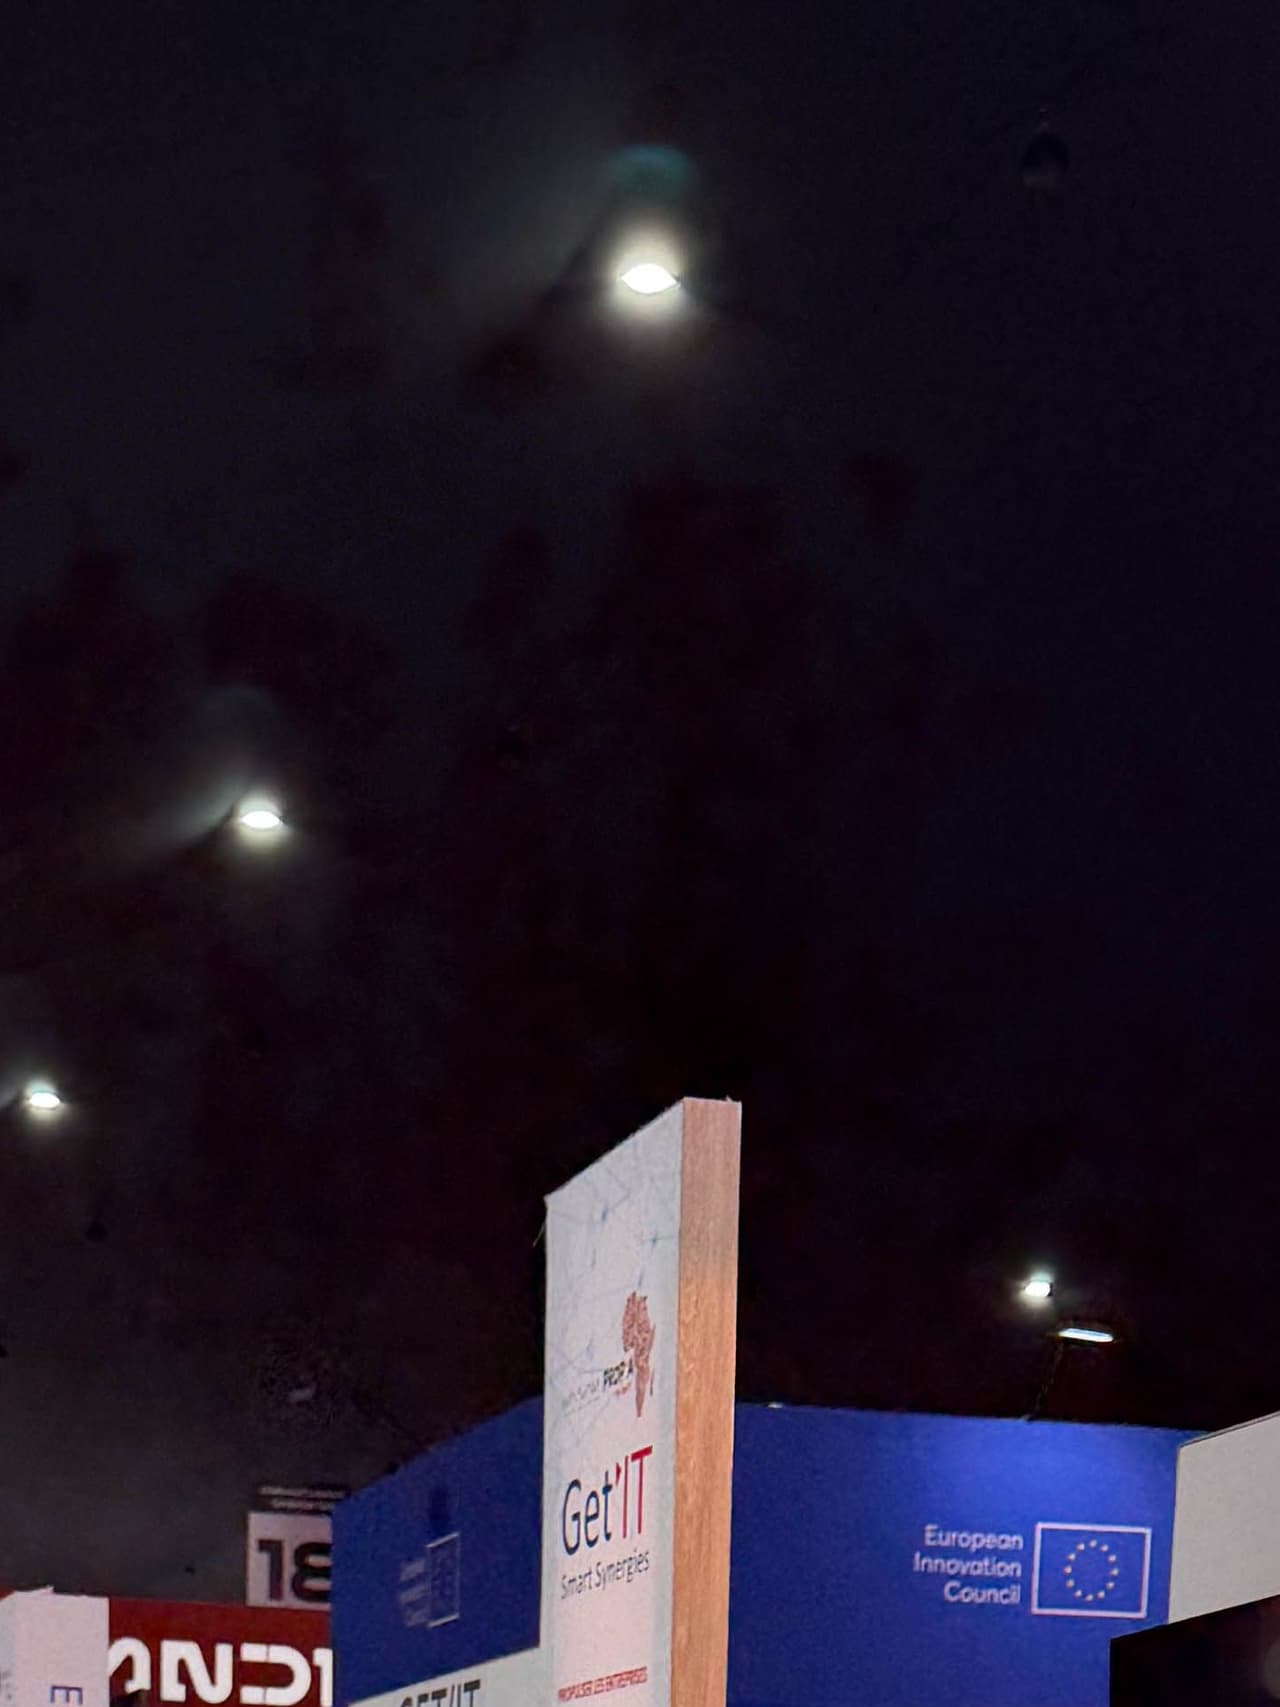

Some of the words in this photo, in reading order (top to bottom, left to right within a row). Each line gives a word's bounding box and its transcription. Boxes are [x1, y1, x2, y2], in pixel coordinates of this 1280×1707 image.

[562, 1445, 654, 1556] Get'IT
[924, 1523, 1024, 1552] European
[913, 1551, 1022, 1578] Innovation
[560, 1567, 593, 1600] Smart
[943, 1580, 1022, 1605] Council
